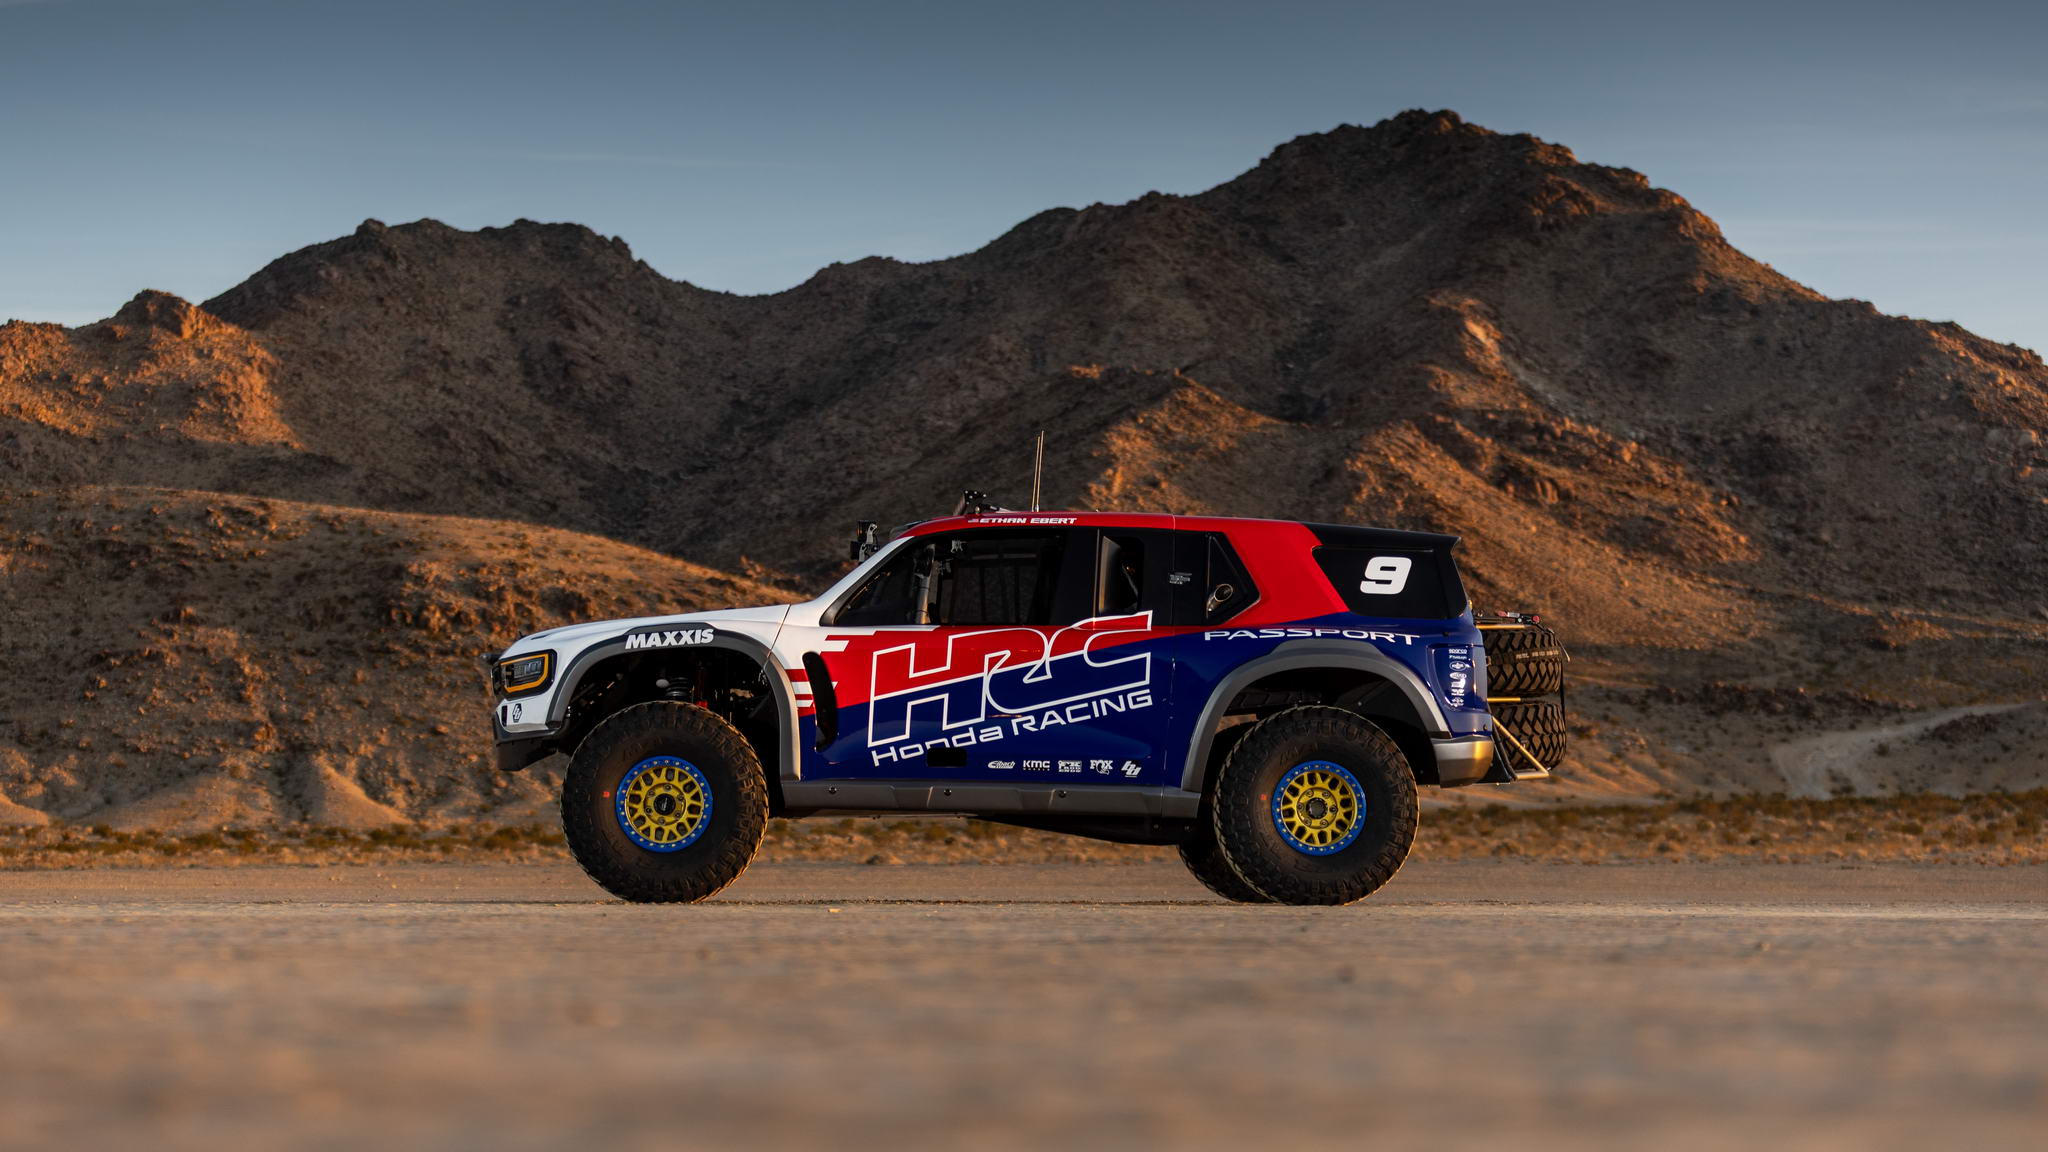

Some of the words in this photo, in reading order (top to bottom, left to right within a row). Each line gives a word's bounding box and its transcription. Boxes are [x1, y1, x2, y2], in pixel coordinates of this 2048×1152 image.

[1360, 556, 1412, 595] 9
[625, 628, 714, 650] MAXXIS
[1204, 628, 1420, 646] PASSPORT
[868, 610, 1153, 747] HRC
[871, 725, 1004, 767] Honda
[1011, 689, 1153, 736] RACING
